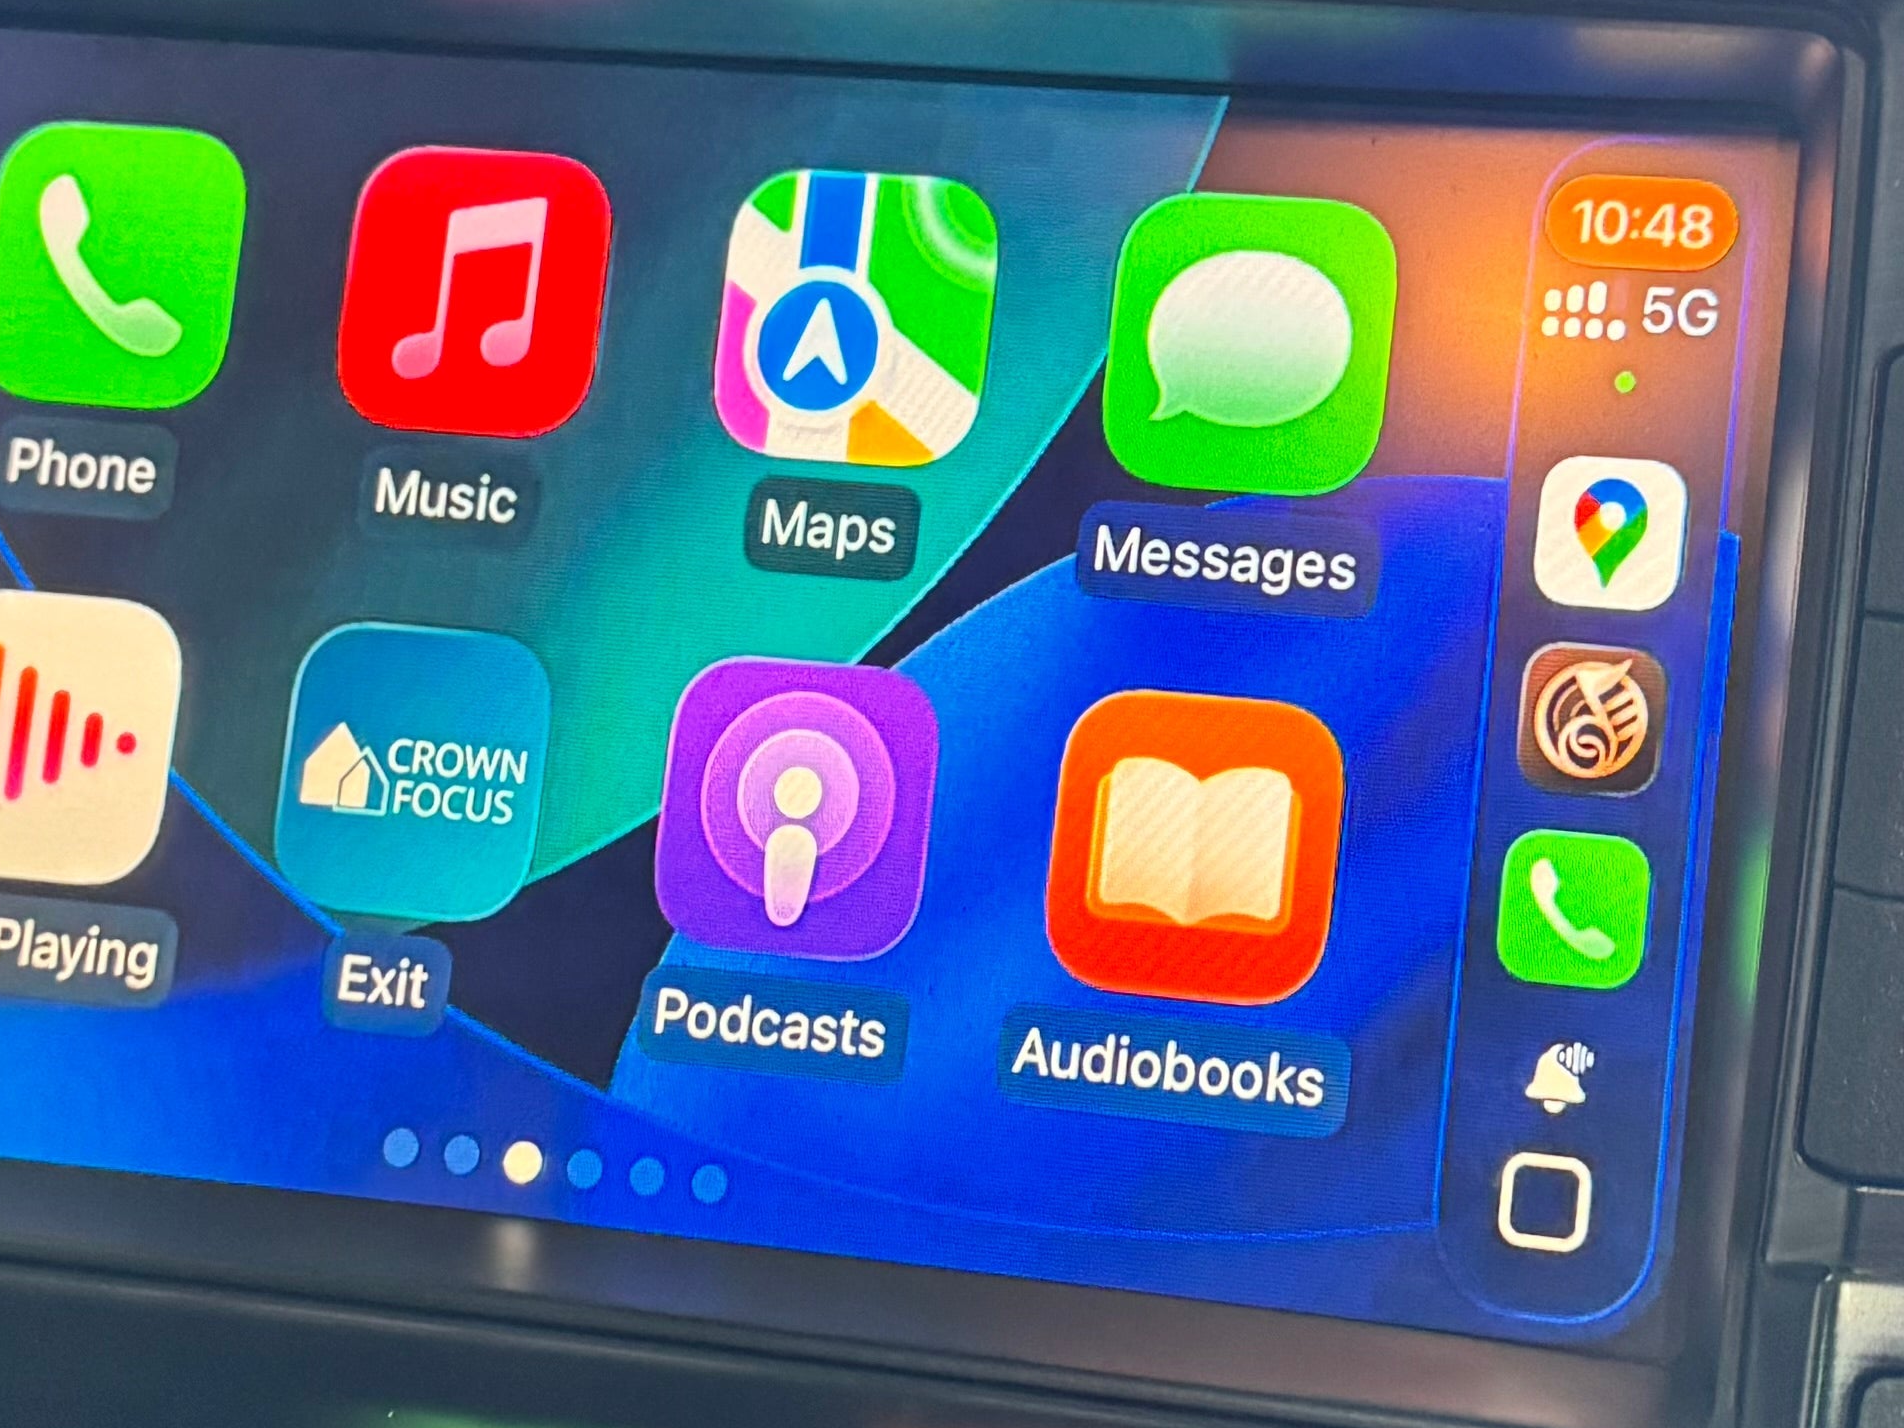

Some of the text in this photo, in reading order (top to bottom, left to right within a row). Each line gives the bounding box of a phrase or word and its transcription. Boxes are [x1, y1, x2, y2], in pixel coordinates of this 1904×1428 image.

[1571, 199, 1714, 249] 10:48
[1642, 286, 1720, 336] 5G
[5, 437, 156, 495] Phone
[374, 468, 518, 526] Music
[760, 501, 897, 558] Maps
[1094, 524, 1357, 596] Messages
[387, 737, 528, 784] CROWN
[394, 778, 514, 825] FOCUS
[336, 953, 430, 1011] Exit
[652, 987, 886, 1058] Podcasts
[1010, 1026, 1326, 1108] Audiobooks
